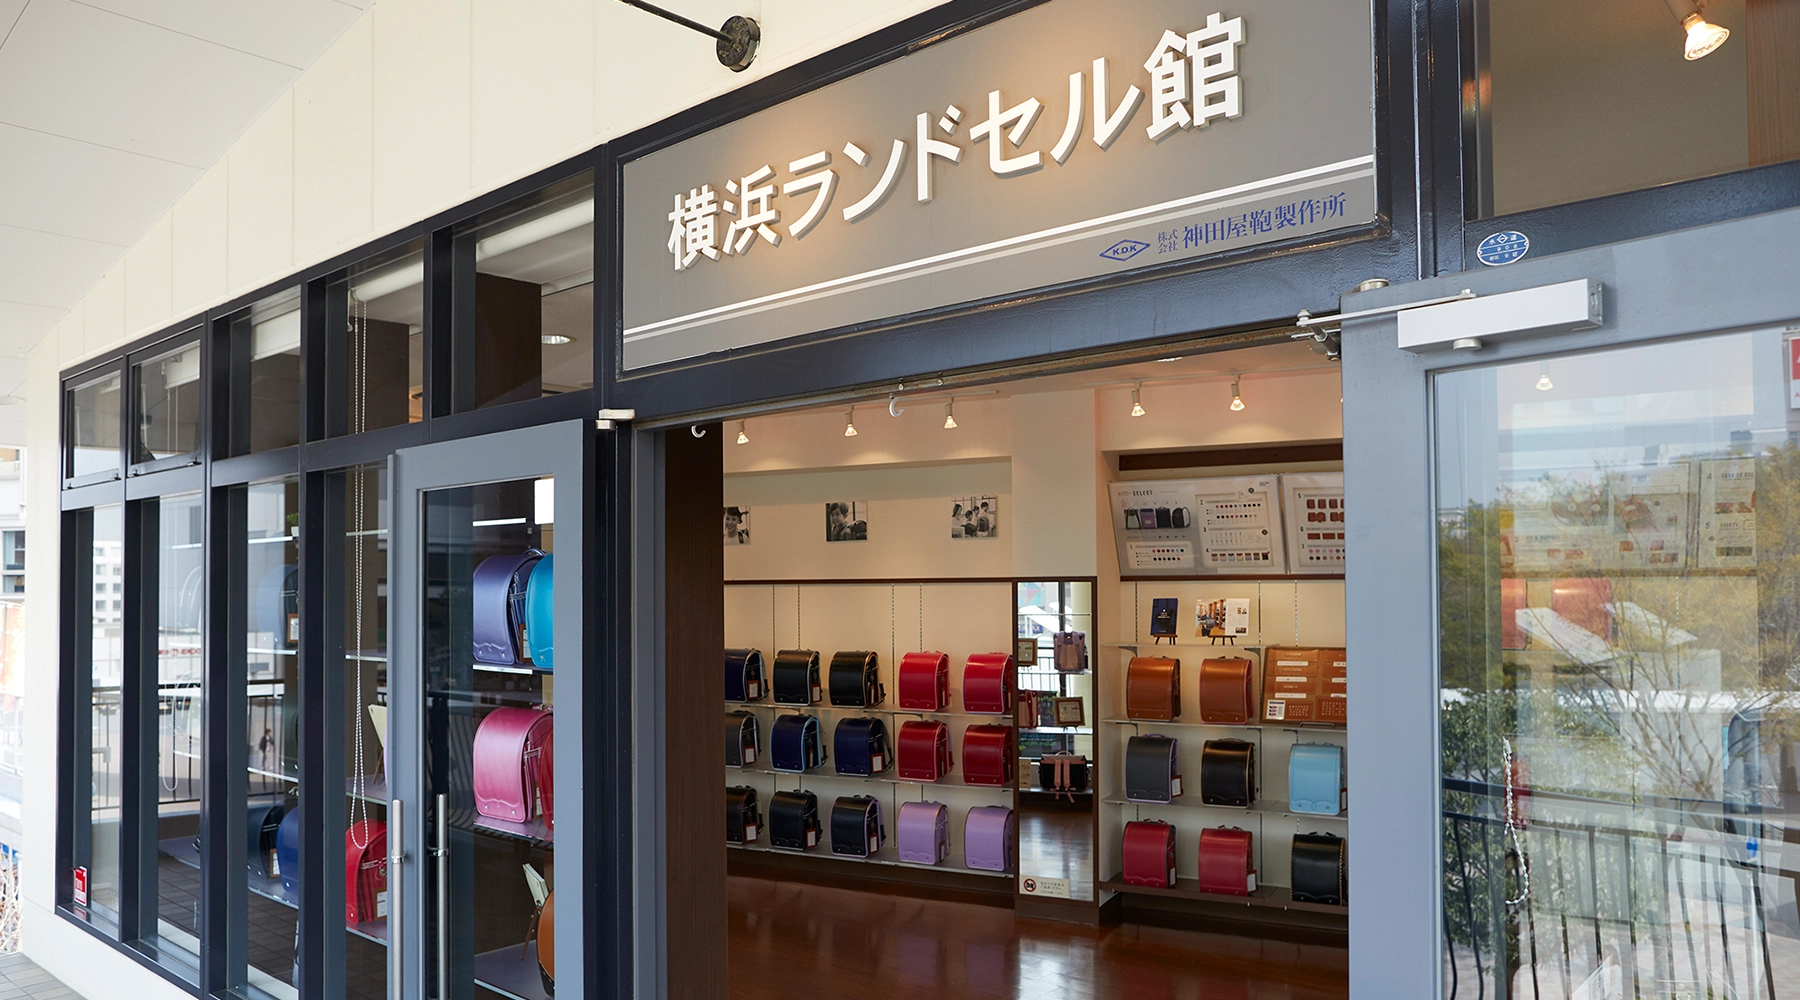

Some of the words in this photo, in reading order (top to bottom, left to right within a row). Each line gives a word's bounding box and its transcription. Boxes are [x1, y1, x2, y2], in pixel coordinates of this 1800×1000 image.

[667, 12, 1246, 271] 横浜ランドセル館
[1181, 191, 1347, 249] 神田屋鞄製作所
[1132, 489, 1153, 497] SELECT
